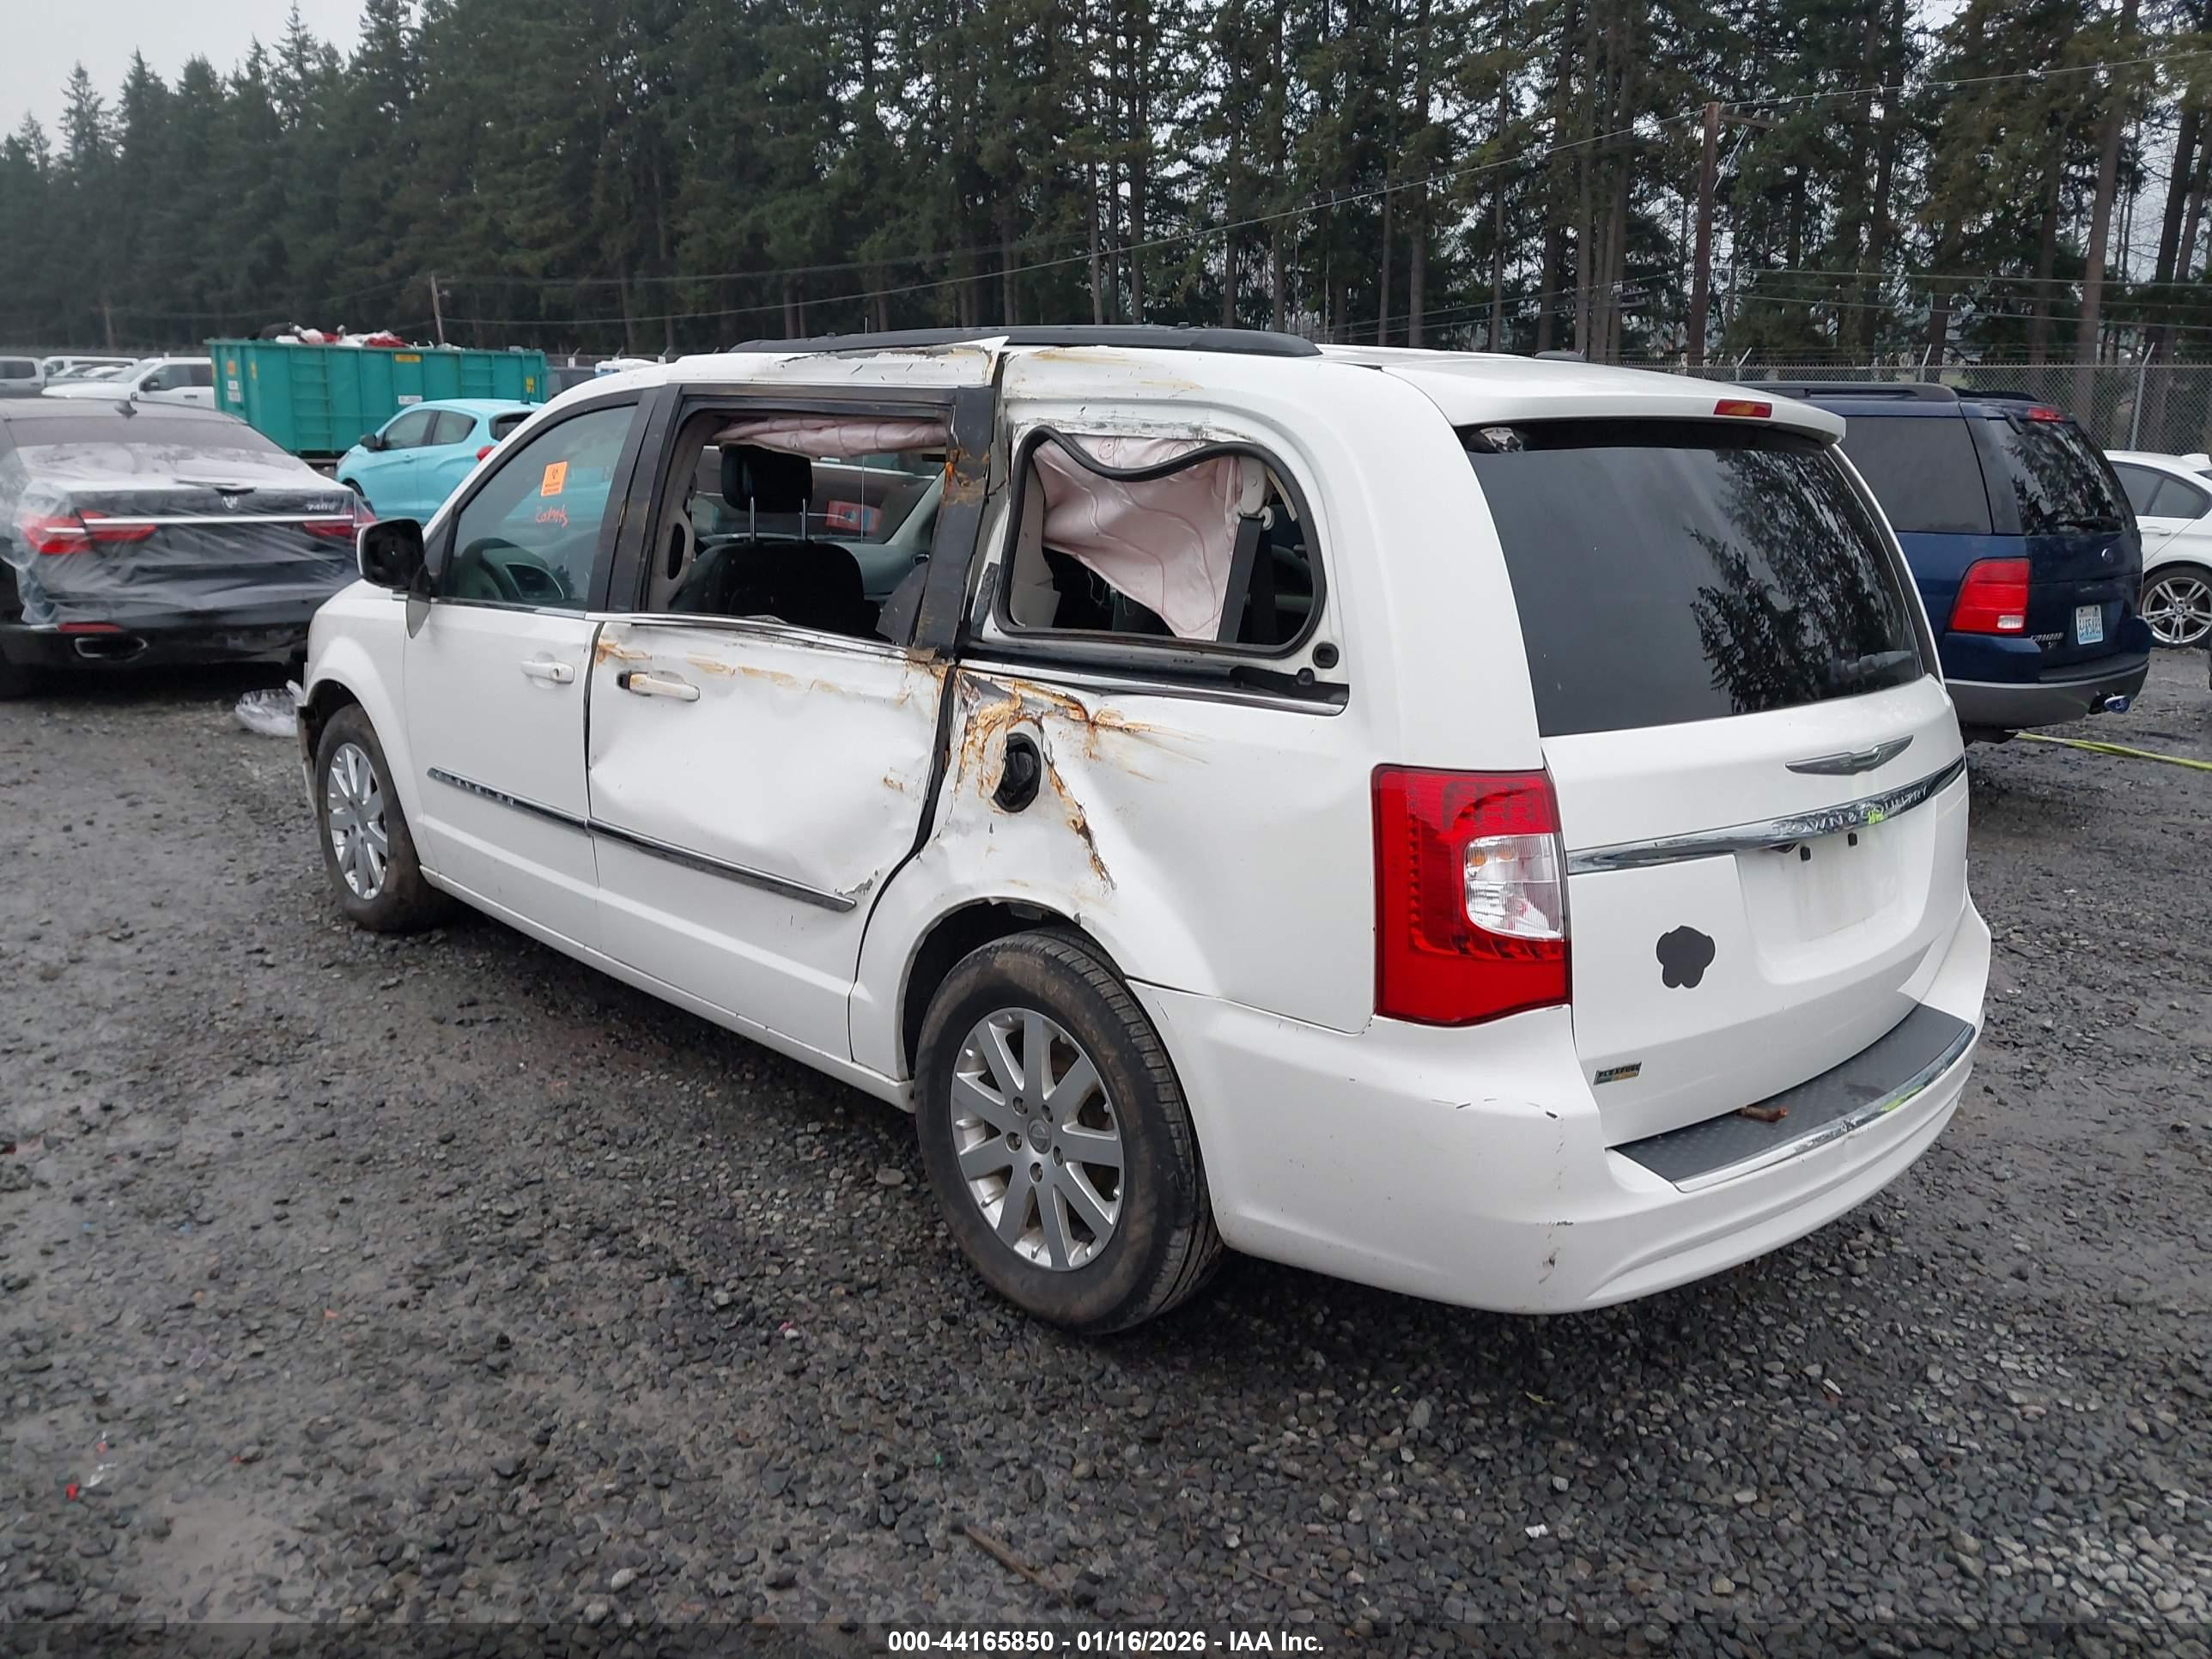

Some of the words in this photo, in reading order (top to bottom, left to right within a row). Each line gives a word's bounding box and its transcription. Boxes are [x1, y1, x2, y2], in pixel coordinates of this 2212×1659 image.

[434, 772, 515, 806] RYSLER
[1771, 814, 1844, 838] TOWN
[1847, 811, 1857, 823] &
